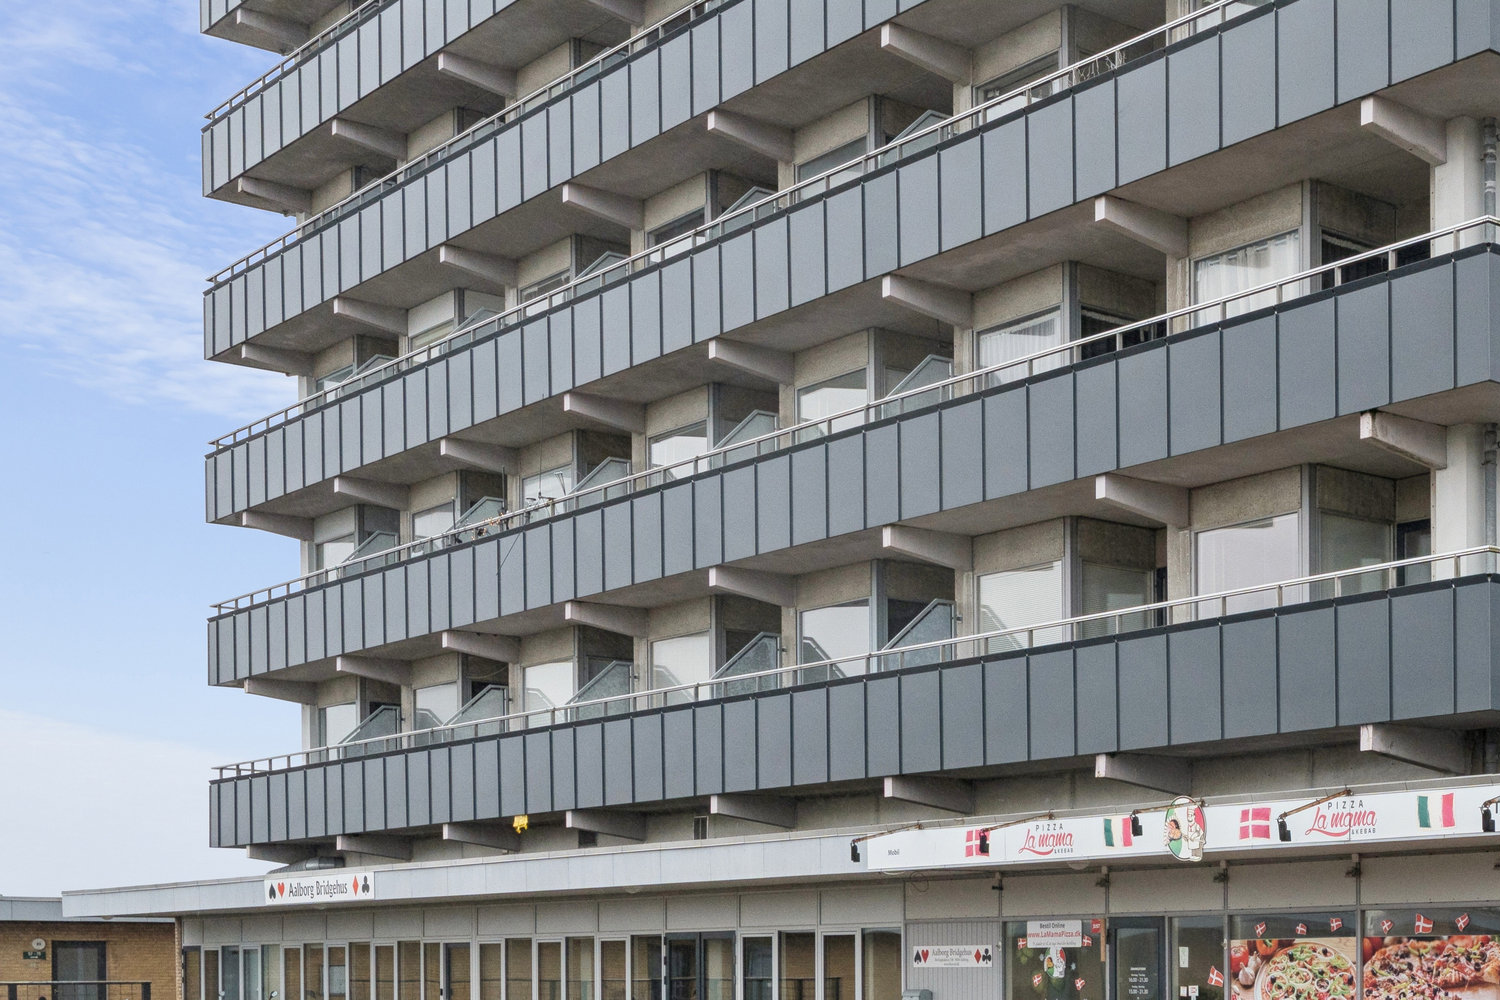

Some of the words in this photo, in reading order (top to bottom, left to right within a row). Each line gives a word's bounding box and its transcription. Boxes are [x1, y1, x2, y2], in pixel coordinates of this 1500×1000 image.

[1328, 800, 1364, 810] PIZZA
[1330, 810, 1377, 828] mama
[1035, 823, 1063, 831] PIZZA
[1039, 832, 1074, 847] mama
[288, 882, 314, 899] Aalborg
[316, 880, 348, 898] Bridgehus
[932, 948, 949, 959] Aalborg
[950, 947, 972, 958] Bridgehus
